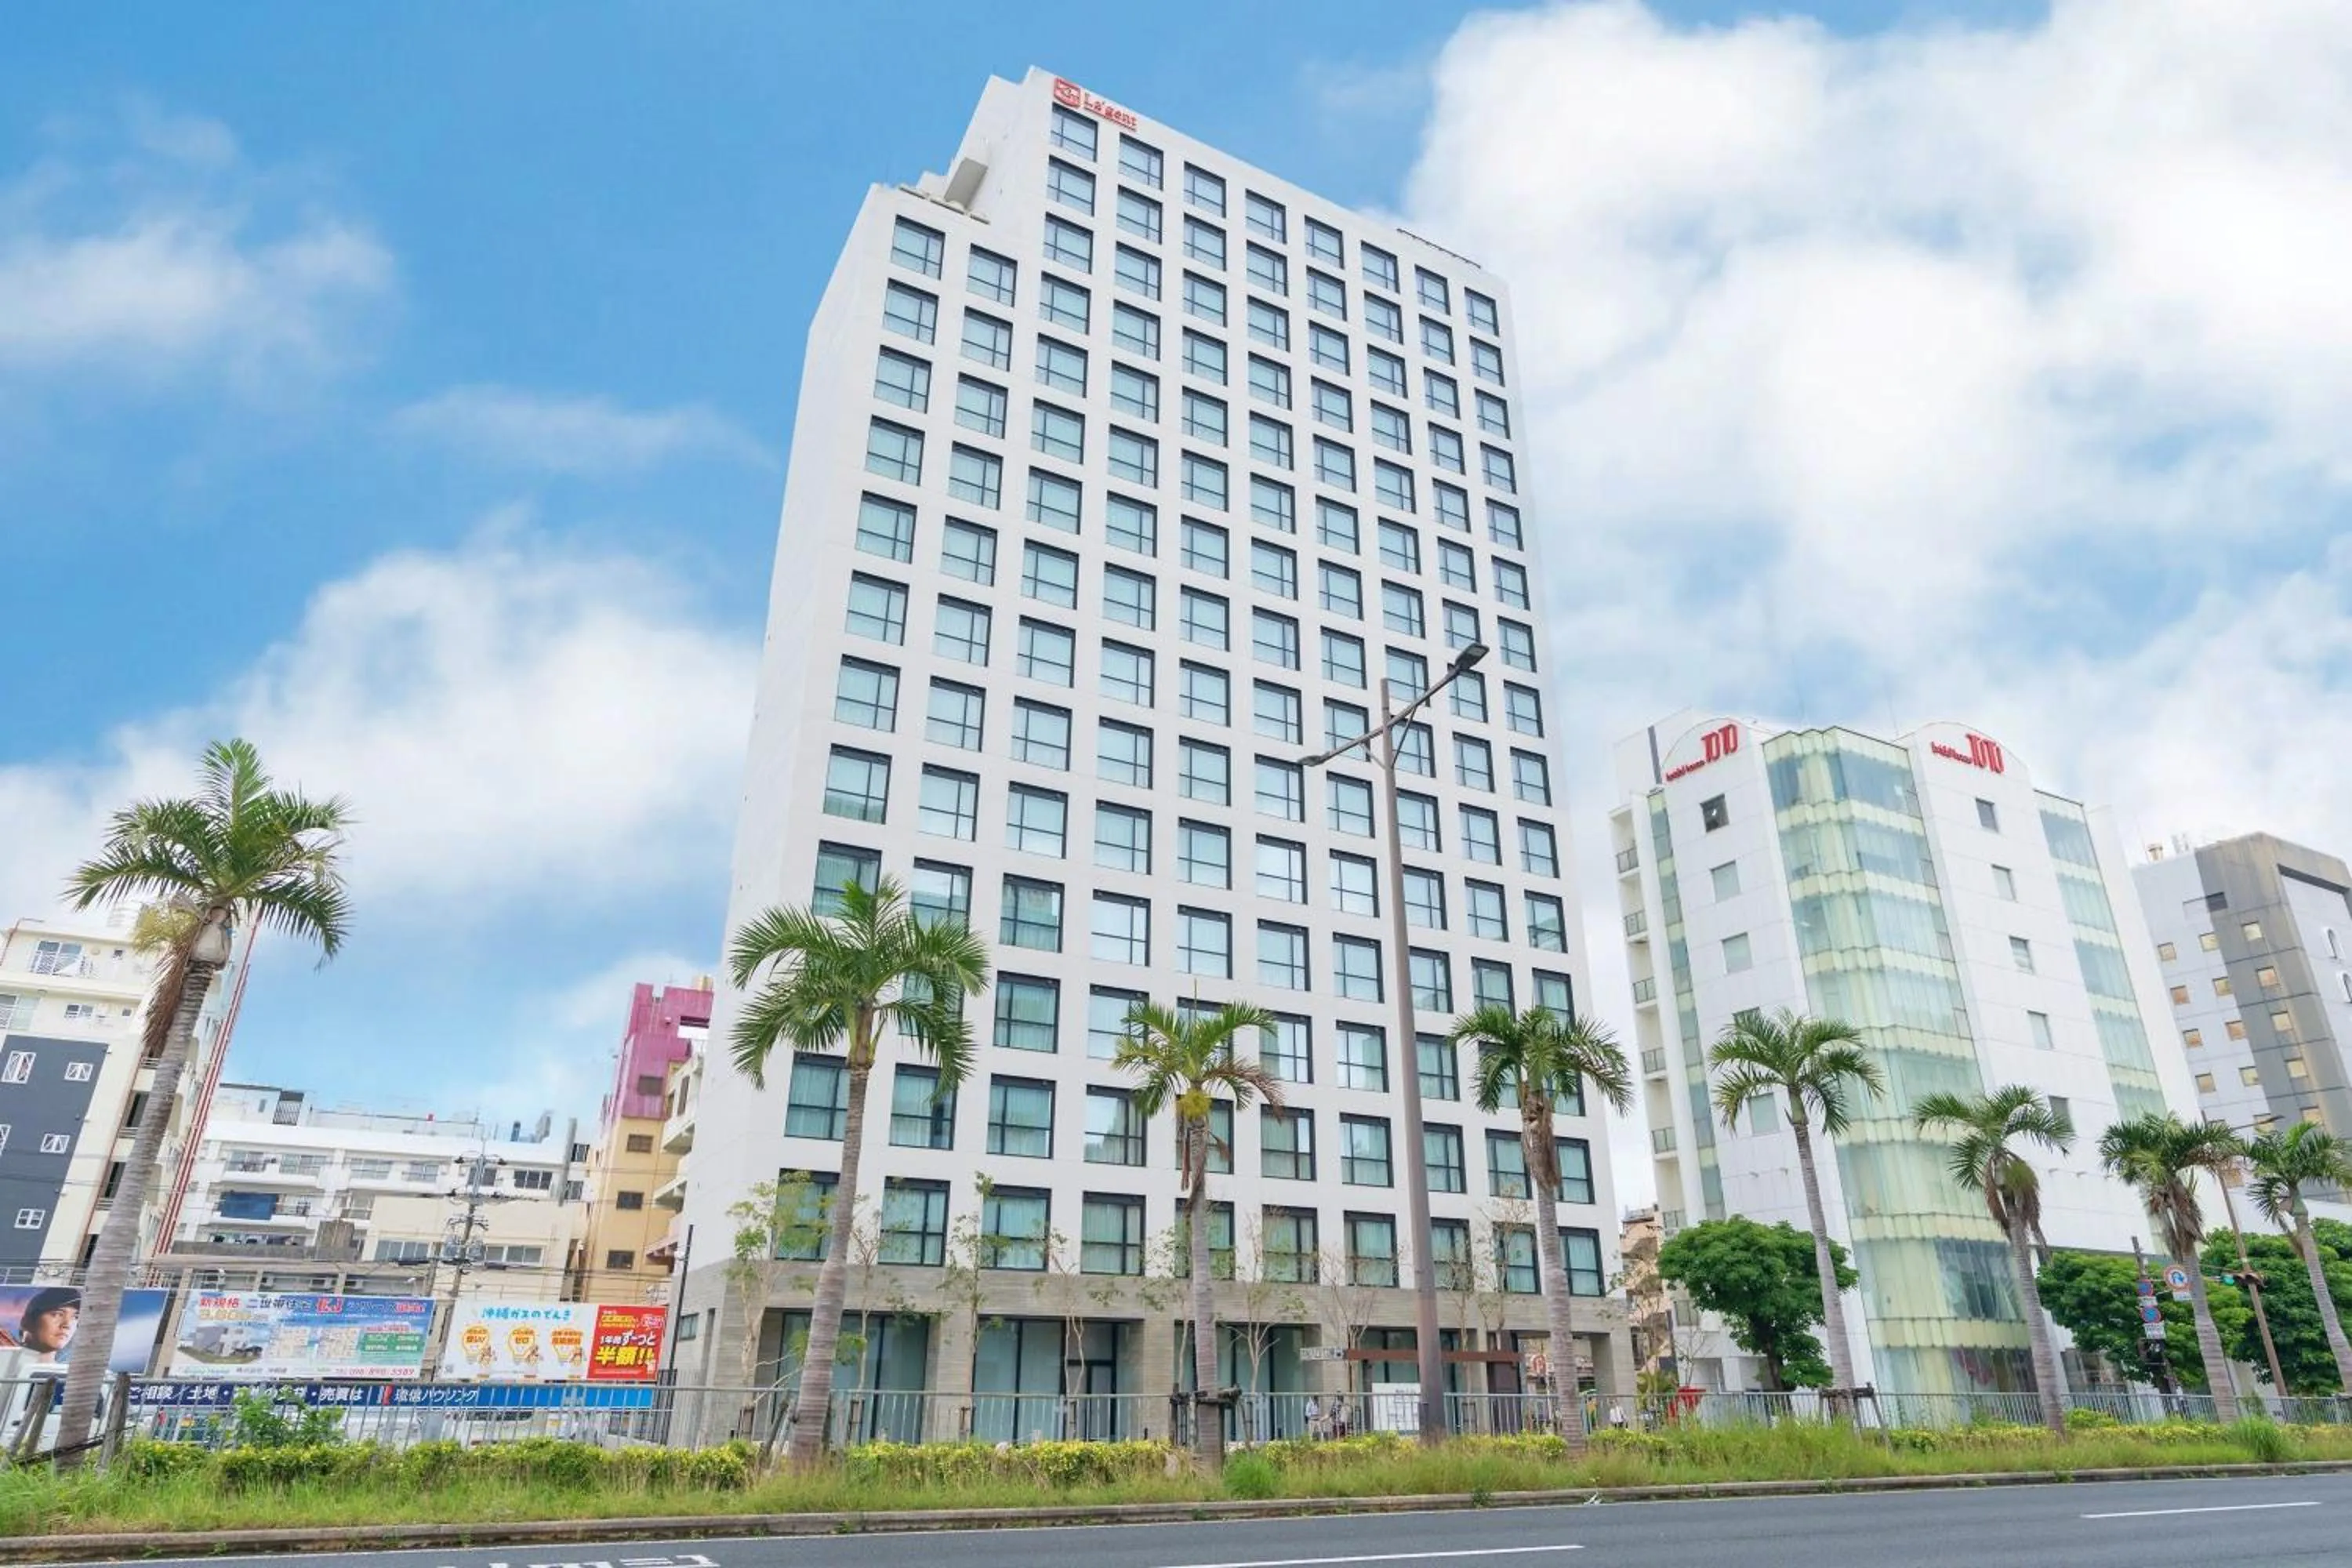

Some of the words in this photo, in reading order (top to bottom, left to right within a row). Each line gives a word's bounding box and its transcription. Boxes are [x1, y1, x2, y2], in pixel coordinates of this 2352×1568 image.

[482, 1306, 571, 1320] 沖縄ガスのでんき
